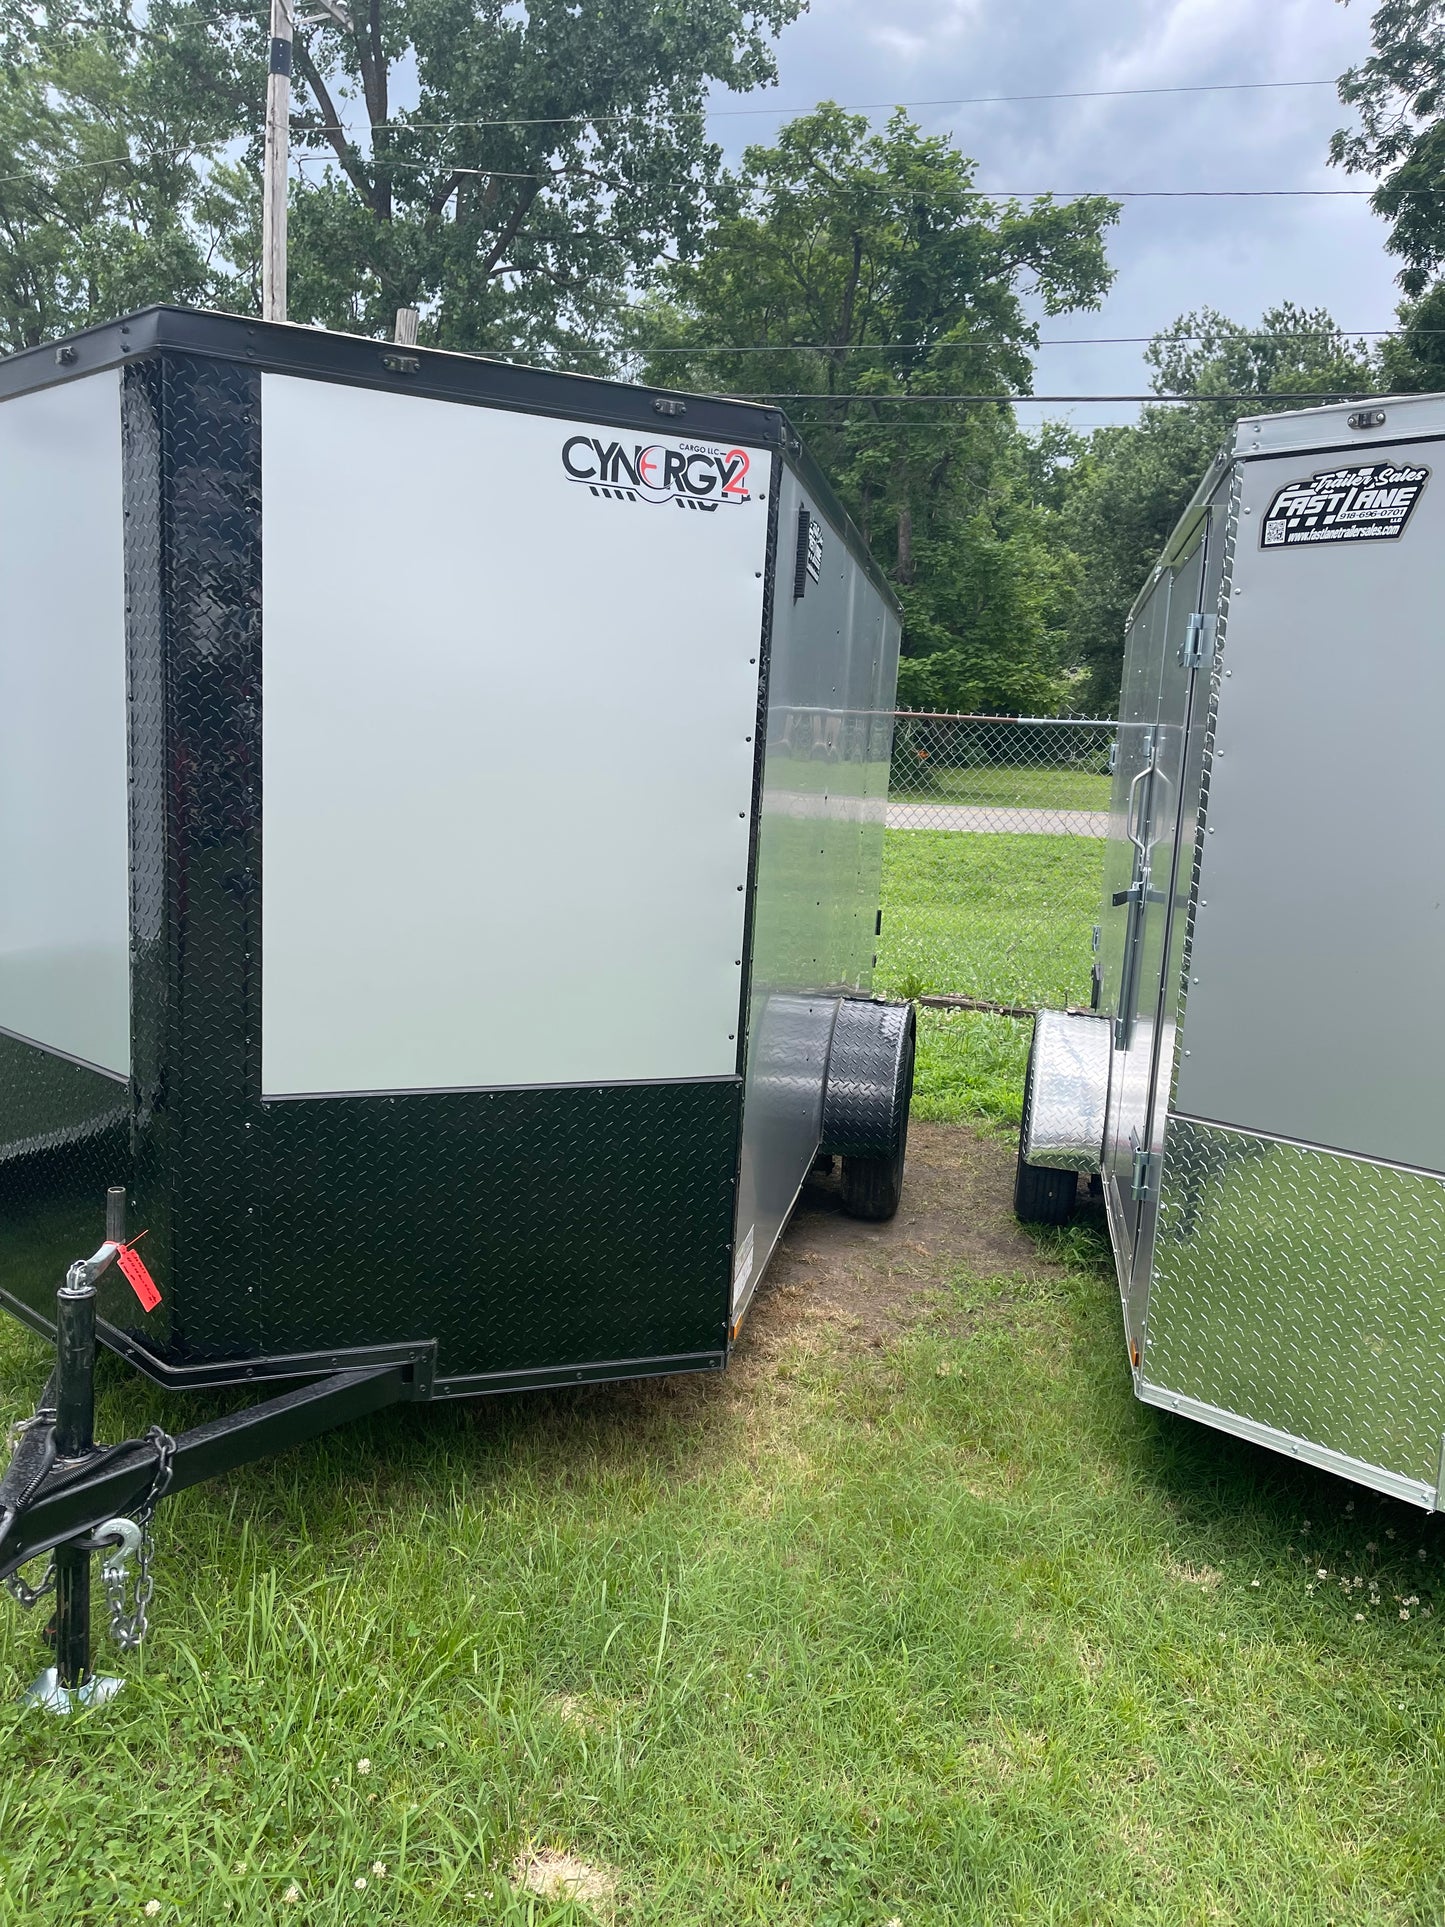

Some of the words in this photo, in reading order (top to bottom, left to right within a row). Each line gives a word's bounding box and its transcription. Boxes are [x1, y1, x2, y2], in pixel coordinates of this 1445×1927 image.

[679, 443, 706, 454] CARGO
[707, 447, 720, 456] LLC
[1315, 473, 1373, 492] Trailer
[1375, 467, 1426, 487] Sales
[1269, 489, 1347, 518] FAST
[1335, 486, 1418, 521] LANE
[1339, 508, 1405, 520] 918-696-0701
[1287, 522, 1400, 542] www.fastlanetrailersales.com
